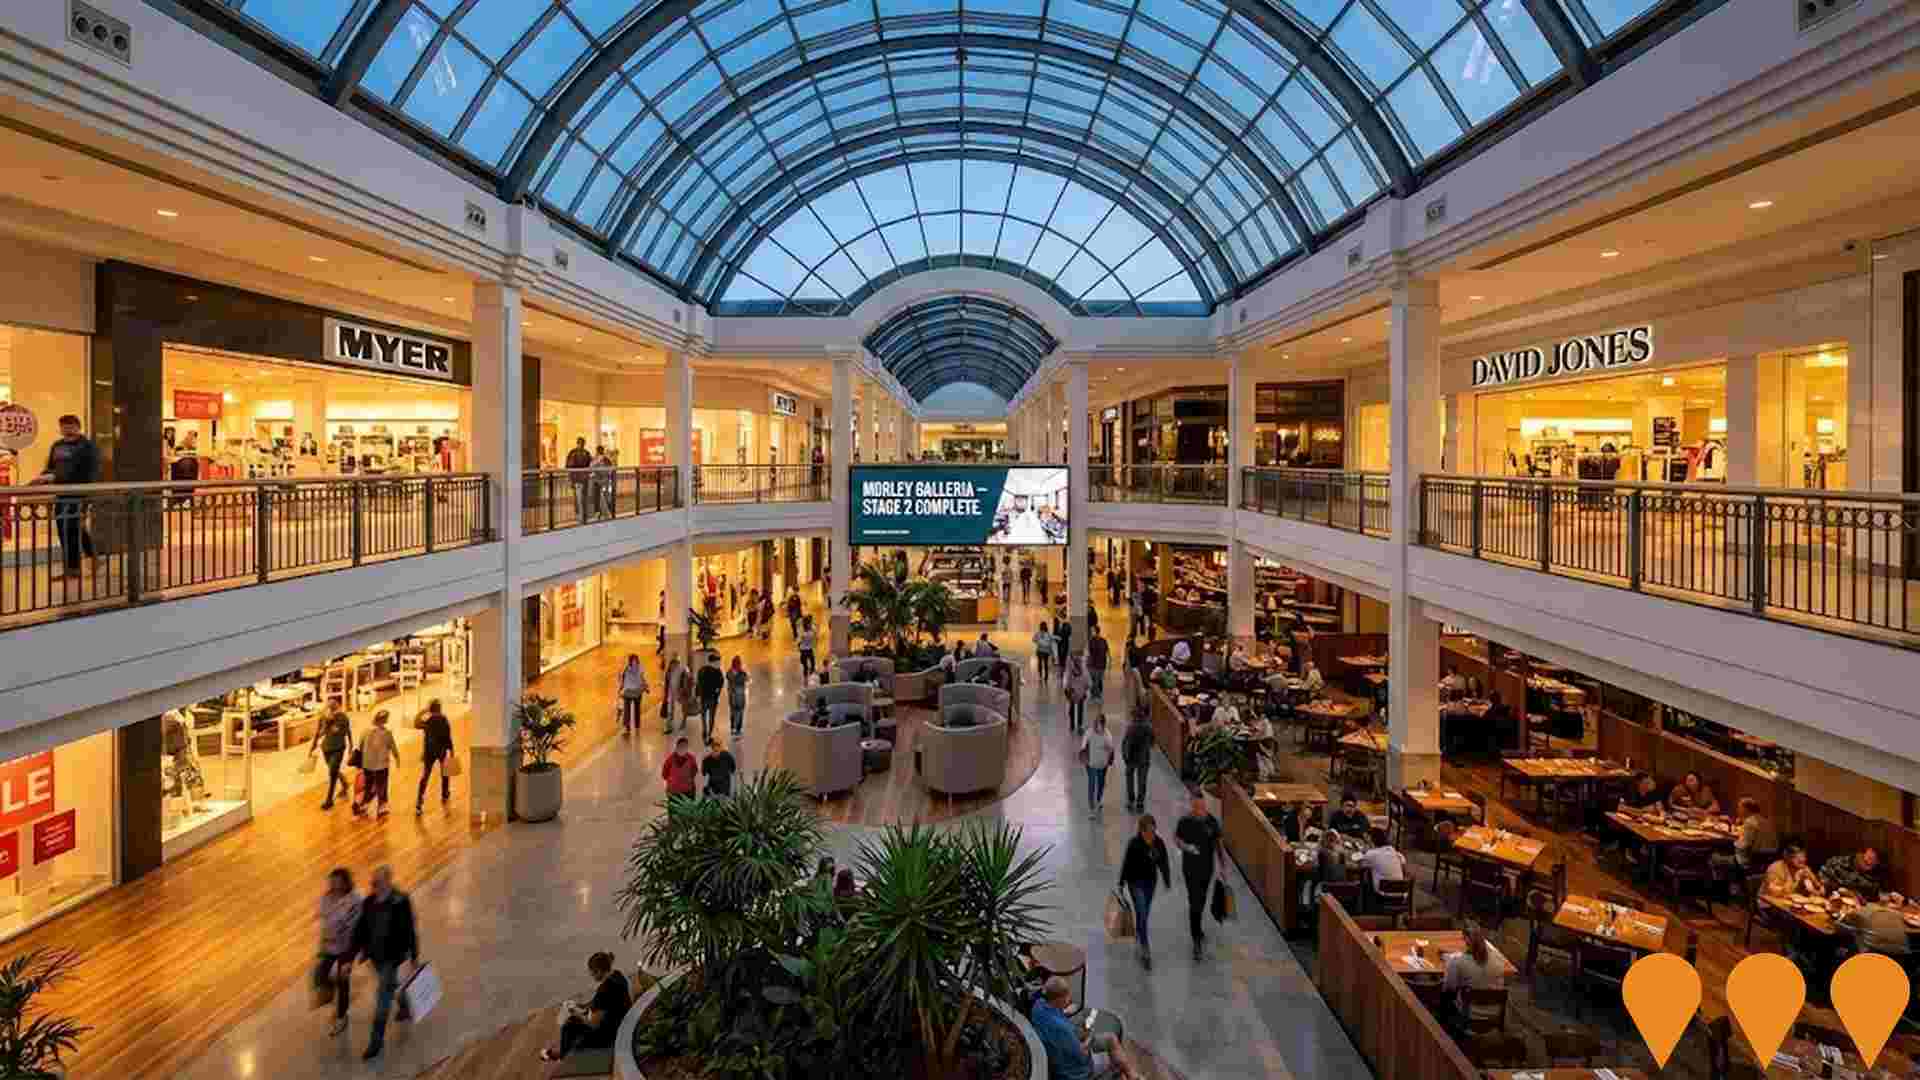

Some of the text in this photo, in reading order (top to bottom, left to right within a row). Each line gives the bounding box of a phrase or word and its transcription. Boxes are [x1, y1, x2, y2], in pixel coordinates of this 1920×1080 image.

[336, 326, 449, 372] MYER
[1472, 325, 1653, 386] DAVID JONES
[863, 480, 914, 497] MORLEY
[903, 498, 913, 515] 2
[915, 498, 982, 515] COMPLETE
